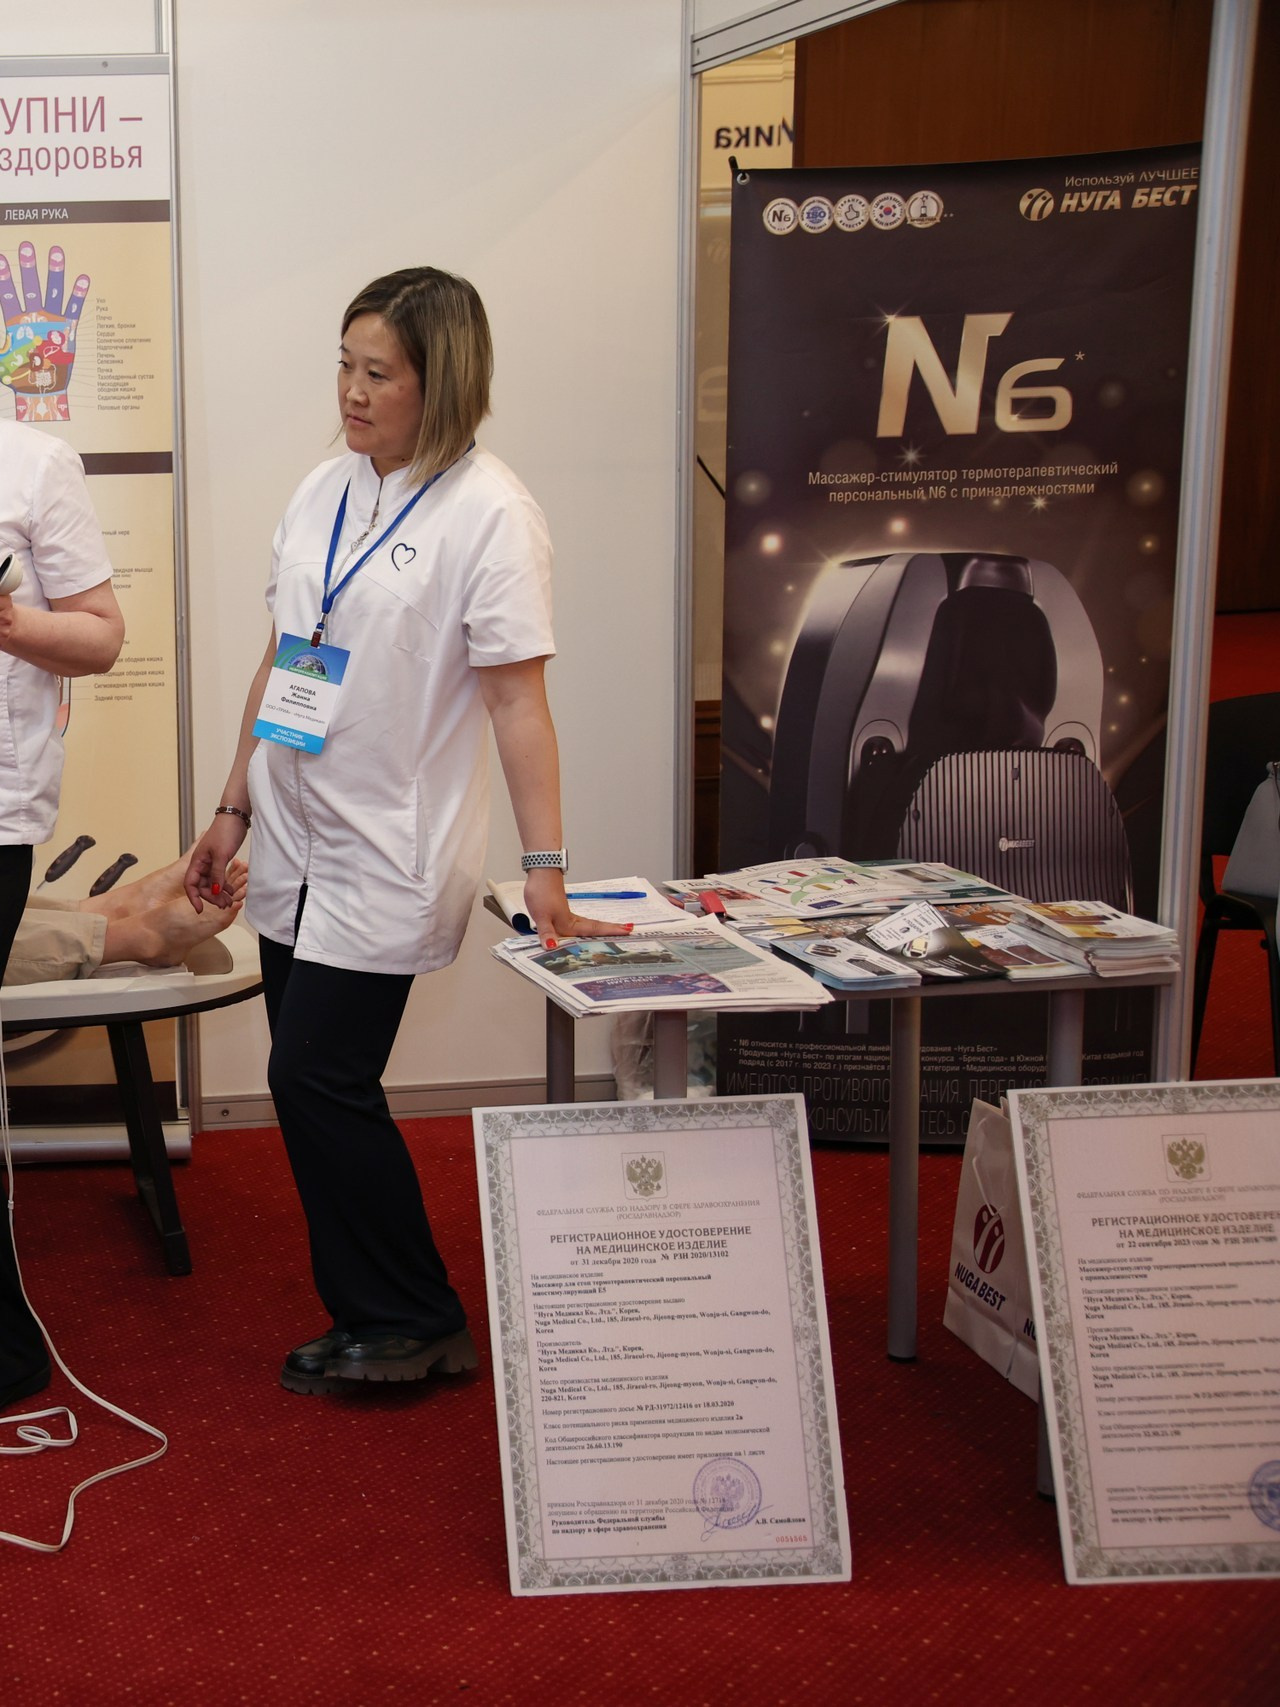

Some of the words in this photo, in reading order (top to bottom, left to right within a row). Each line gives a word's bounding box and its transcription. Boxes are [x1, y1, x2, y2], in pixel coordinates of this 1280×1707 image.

[0, 145, 142, 177] здоровья
[1065, 172, 1134, 187] Используй
[1138, 167, 1198, 183] ЛУЧШЕЕ
[1060, 189, 1121, 213] НУГА
[1131, 184, 1198, 208] БЕСТ
[5, 210, 36, 220] ЛЕВАЯ
[38, 208, 68, 219] РУКА
[772, 210, 791, 222] N6
[806, 211, 826, 219] ISO
[876, 312, 1072, 438] N6
[809, 467, 957, 484] Массажер-стимулятор
[962, 461, 1118, 480] термотерапевтический
[829, 485, 924, 504] персональный
[929, 485, 946, 498] N6
[951, 489, 958, 498] с
[962, 481, 1094, 498] принадлежностями
[290, 684, 316, 696] АГАПОВА
[291, 692, 310, 701] Жанна
[281, 697, 317, 711] Филипповна
[739, 1049, 777, 1057] Продукция
[776, 1060, 793, 1068] 2017
[814, 1062, 831, 1070] 2023
[586, 1206, 614, 1214] СЛУЖБА
[1092, 1214, 1201, 1227] РЕГИСТРАЦИОННОЕ
[1204, 1210, 1280, 1223] УДОСТОВЕРЕ
[550, 1230, 656, 1244] РЕГИСТРАЦИОННОЕ
[659, 1226, 751, 1240] УДОСТОВЕРЕНИЕ
[1119, 1230, 1134, 1239] НА
[1137, 1225, 1220, 1238] МЕДИЦИНСКОЕ
[1223, 1223, 1274, 1235] ИЗДЕЛИЕ
[577, 1245, 591, 1255] НА
[593, 1241, 675, 1255] МЕДИЦИНСКОЕ
[677, 1239, 727, 1251] ИЗДЕЛИЕ
[582, 1258, 590, 1266] 31
[592, 1257, 621, 1267] декабря
[623, 1256, 638, 1265] 2020
[640, 1257, 656, 1265] года
[673, 1252, 689, 1261] РЗН
[690, 1250, 729, 1260] 2020/13102
[666, 1274, 712, 1282] персональный
[955, 1262, 977, 1294] NUGA
[978, 1281, 1006, 1311] BEST
[535, 1319, 551, 1327] Nuga
[538, 1357, 554, 1365] Nuga
